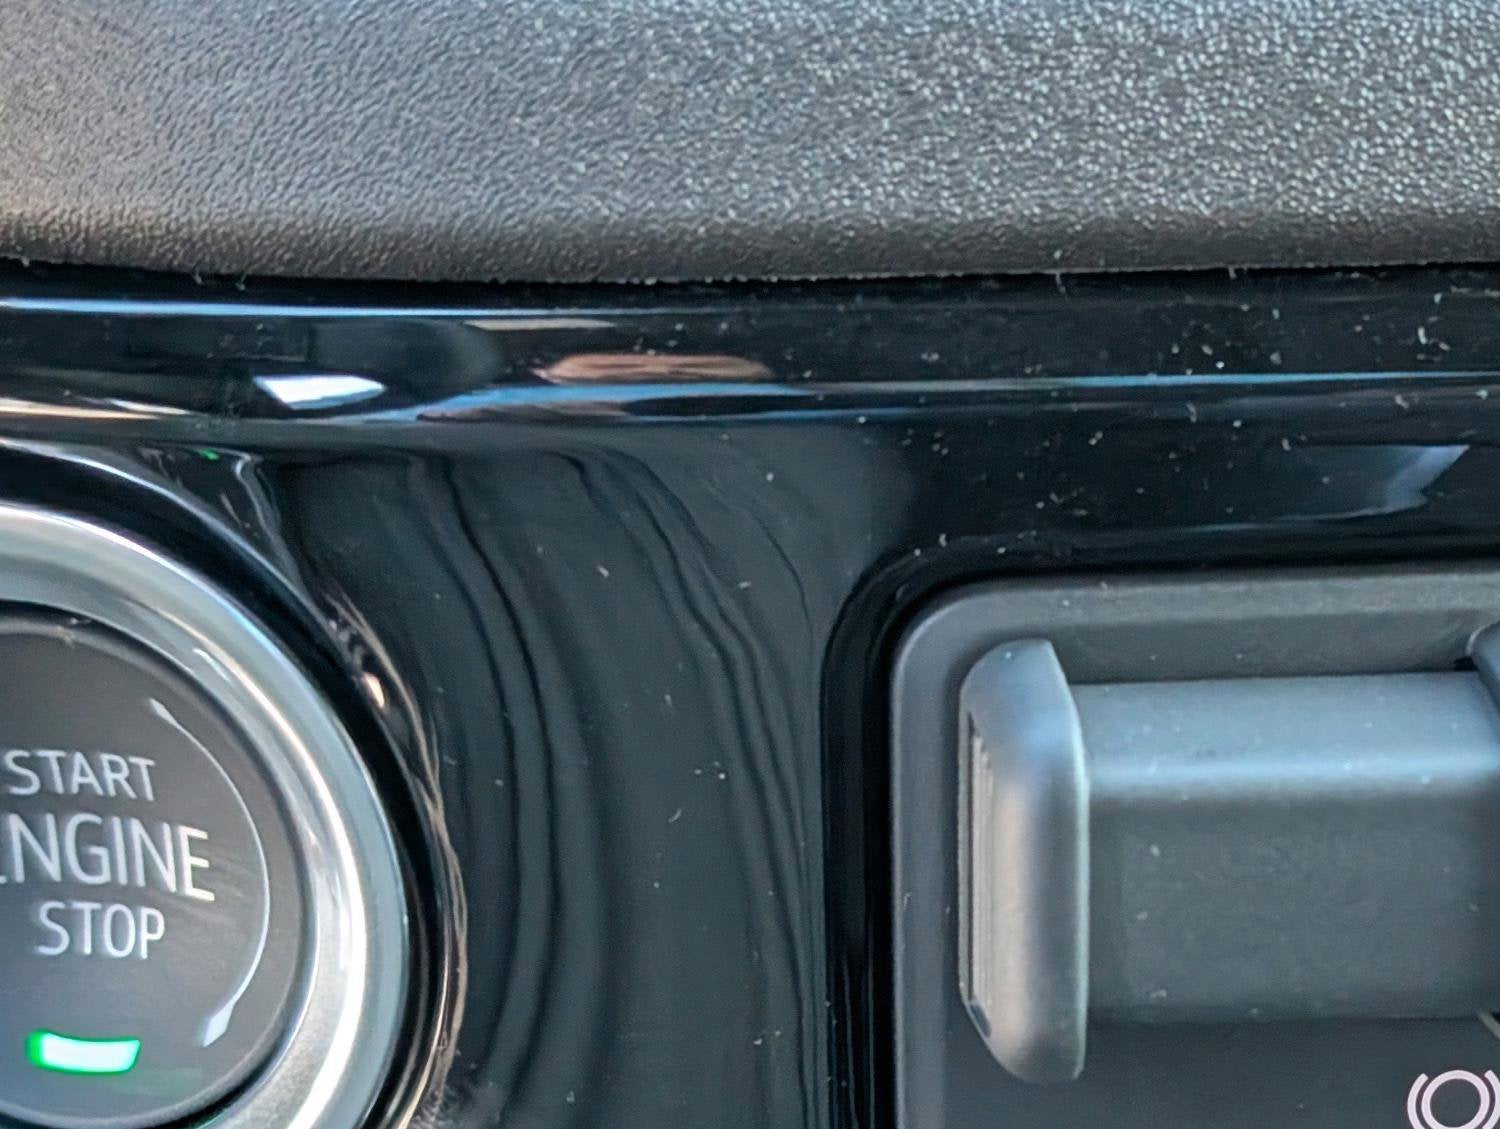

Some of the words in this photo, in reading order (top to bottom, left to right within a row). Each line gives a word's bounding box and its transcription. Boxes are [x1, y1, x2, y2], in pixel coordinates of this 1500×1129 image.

[4, 749, 155, 802] START
[0, 812, 215, 902] NGINE
[37, 900, 166, 960] STOP
